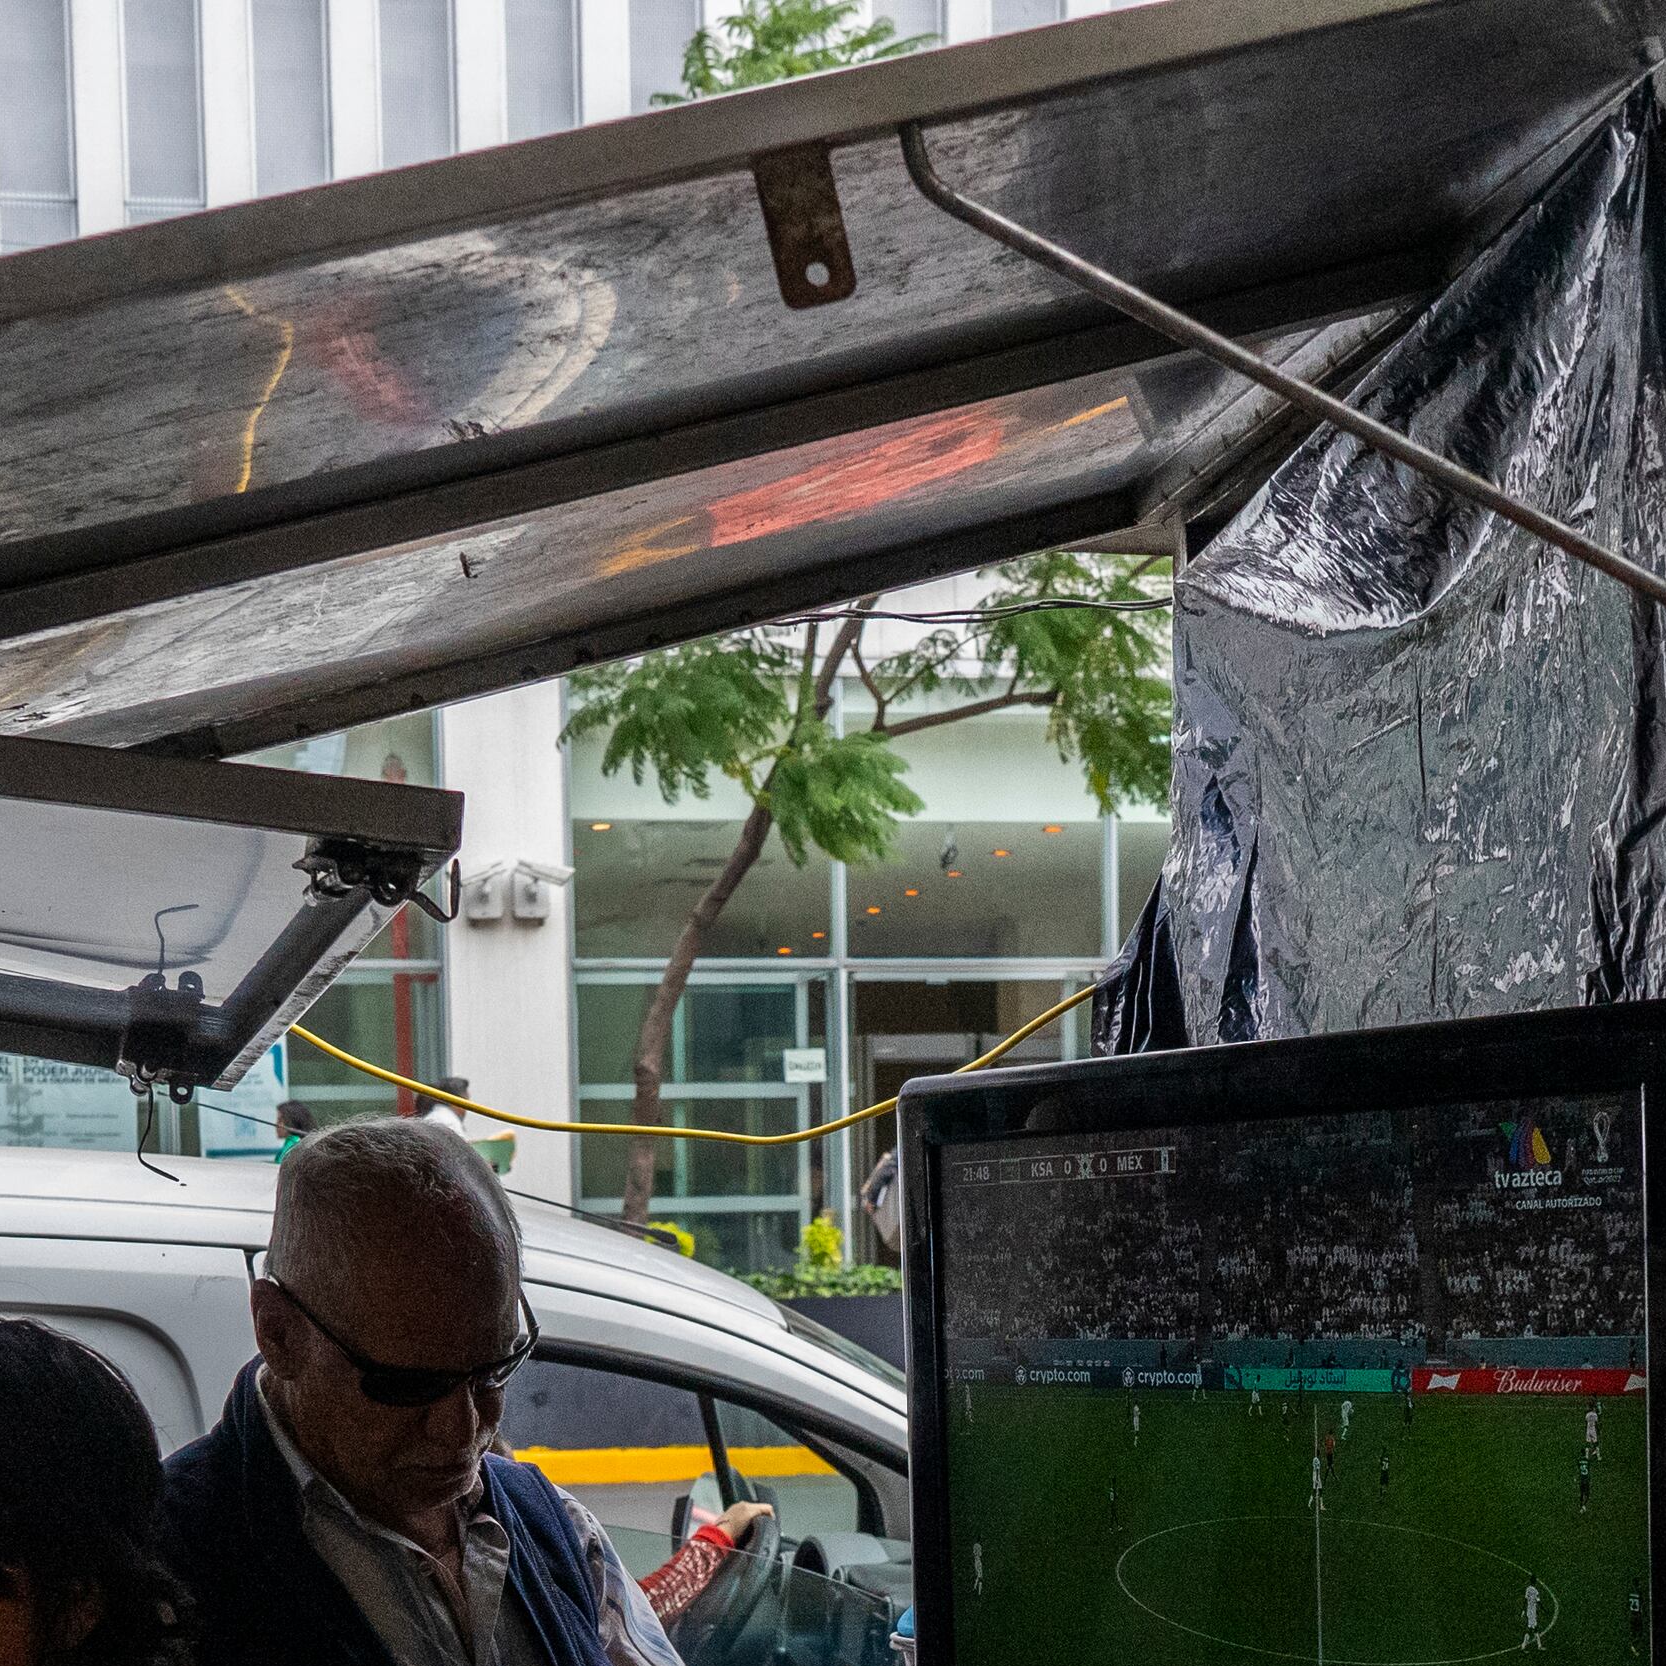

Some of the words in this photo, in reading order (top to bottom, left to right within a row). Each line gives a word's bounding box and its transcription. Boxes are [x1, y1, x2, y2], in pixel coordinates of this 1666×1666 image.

[22, 1067, 68, 1076] PODER
[962, 1165, 990, 1182] 21:48
[1030, 1162, 1053, 1178] KSA
[1064, 1161, 1072, 1175] 0
[1099, 1158, 1108, 1173] 0
[1493, 1169, 1511, 1190] tv
[1511, 1168, 1563, 1188] azteca
[1515, 1199, 1544, 1211] CANAL
[1544, 1196, 1603, 1209] AUTORIZADO
[1029, 1367, 1091, 1384] crypto.com
[1495, 1369, 1583, 1394] Budweiser
